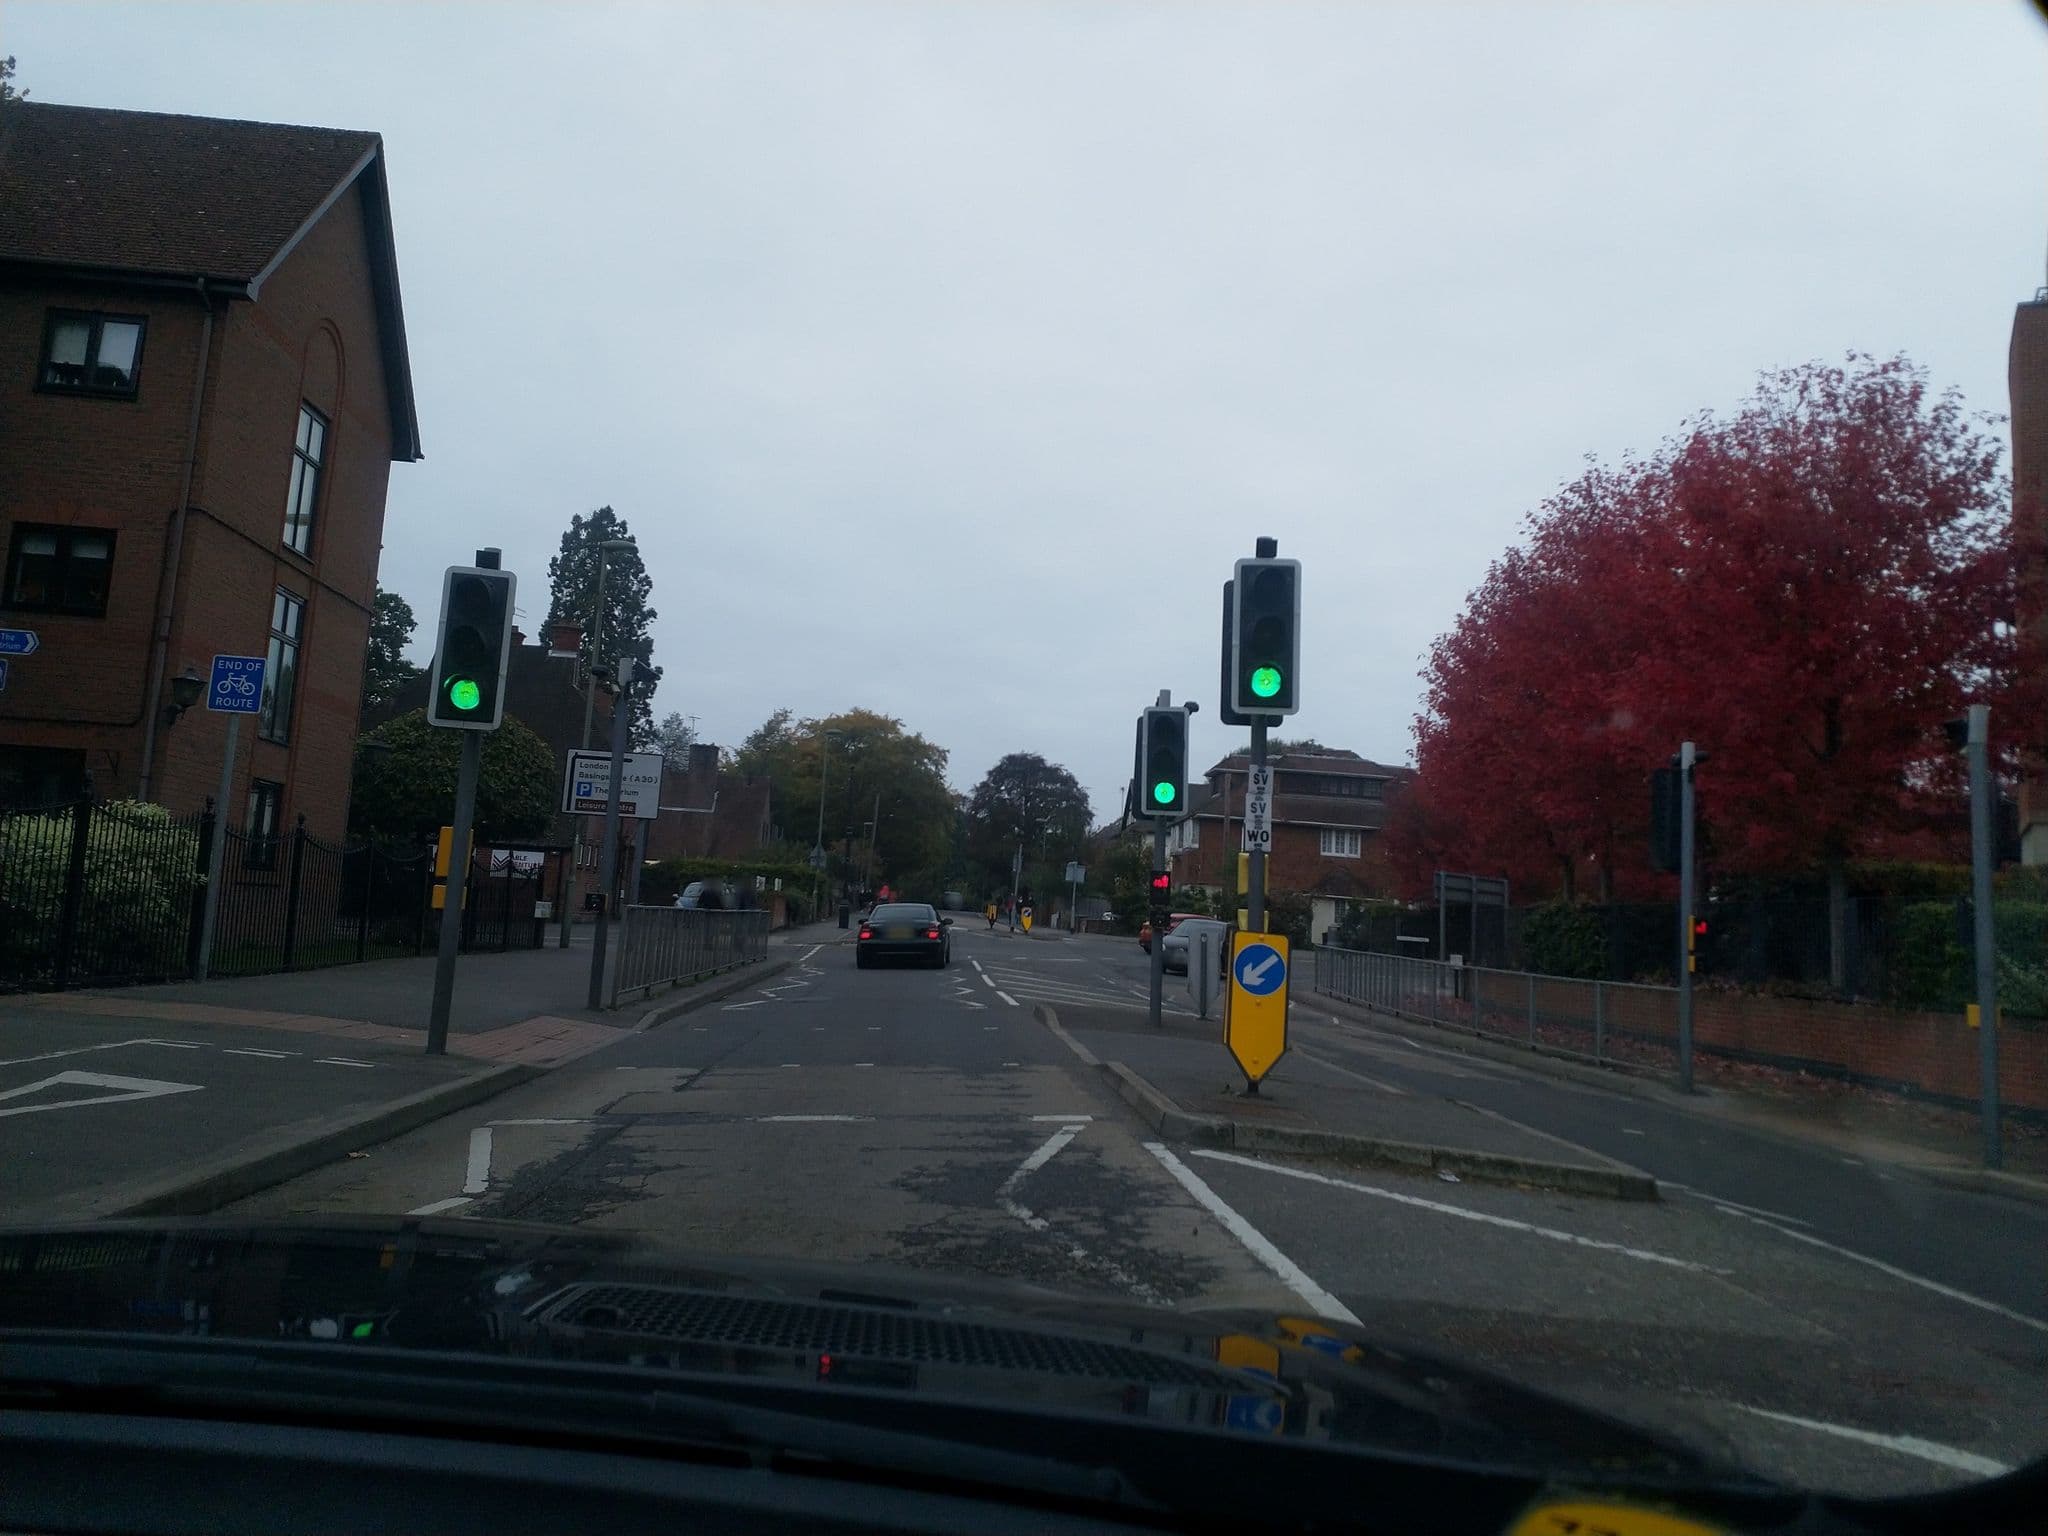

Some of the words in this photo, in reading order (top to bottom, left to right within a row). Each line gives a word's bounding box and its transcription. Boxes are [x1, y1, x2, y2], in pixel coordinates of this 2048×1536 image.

[217, 660, 243, 671] END
[246, 662, 262, 671] OF
[215, 697, 253, 708] ROUTE
[579, 762, 609, 771] London
[578, 772, 627, 782] Basingse
[1253, 773, 1269, 785] SV
[594, 786, 609, 796] The
[577, 801, 606, 810] Leisure
[1250, 801, 1267, 814] SV
[1247, 829, 1270, 843] WO
